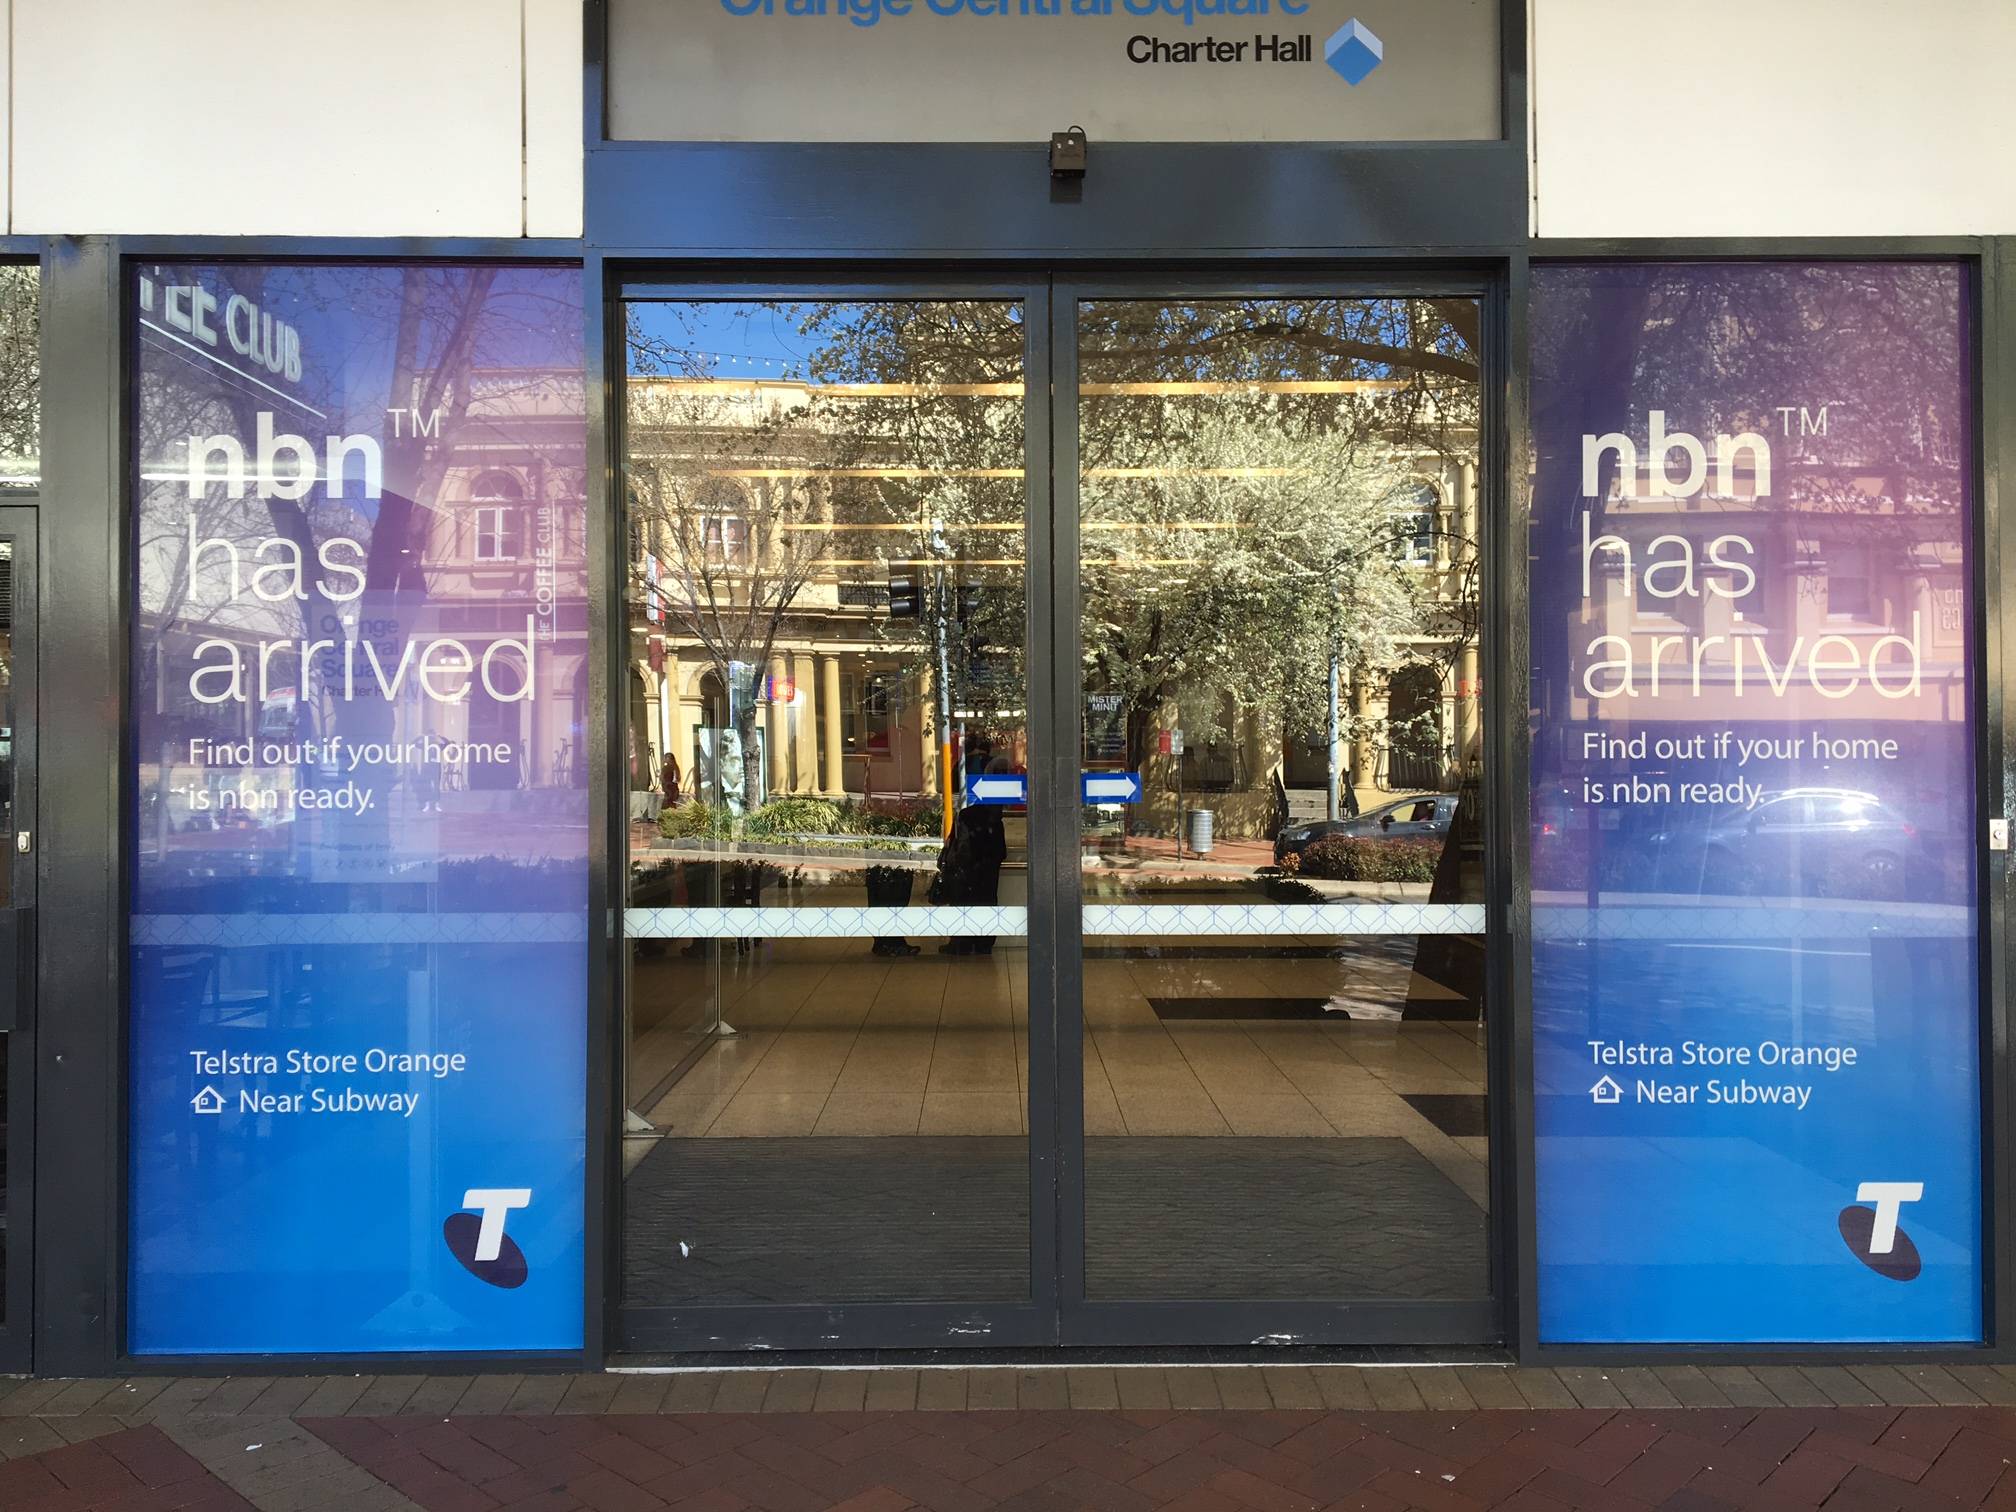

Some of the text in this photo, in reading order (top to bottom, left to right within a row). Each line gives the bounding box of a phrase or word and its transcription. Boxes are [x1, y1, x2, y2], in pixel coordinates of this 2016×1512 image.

[1127, 35, 1312, 63] Charter Hall
[226, 294, 302, 383] CLUB
[189, 411, 382, 499] nbn
[1582, 410, 1771, 498] nbn
[537, 507, 551, 543] CLUB
[188, 513, 367, 601] has
[1582, 510, 1756, 599] has
[536, 547, 553, 616] COFFEE
[189, 614, 535, 703] arrived
[1582, 610, 1921, 698] arrived
[1088, 695, 1123, 703] MISTER
[189, 735, 512, 772] Find out if your home
[1583, 731, 1899, 766] Find out if your home
[189, 781, 376, 816] is nbn ready.
[1583, 776, 1765, 810] is nbn ready.
[190, 1049, 466, 1078] Telstra Store Orange
[1588, 1040, 1857, 1071] Telstra Store Orange
[239, 1088, 419, 1118] Near Subway
[1636, 1079, 1812, 1110] Near Subway
[462, 1188, 532, 1262] T
[1856, 1182, 1924, 1254] T
